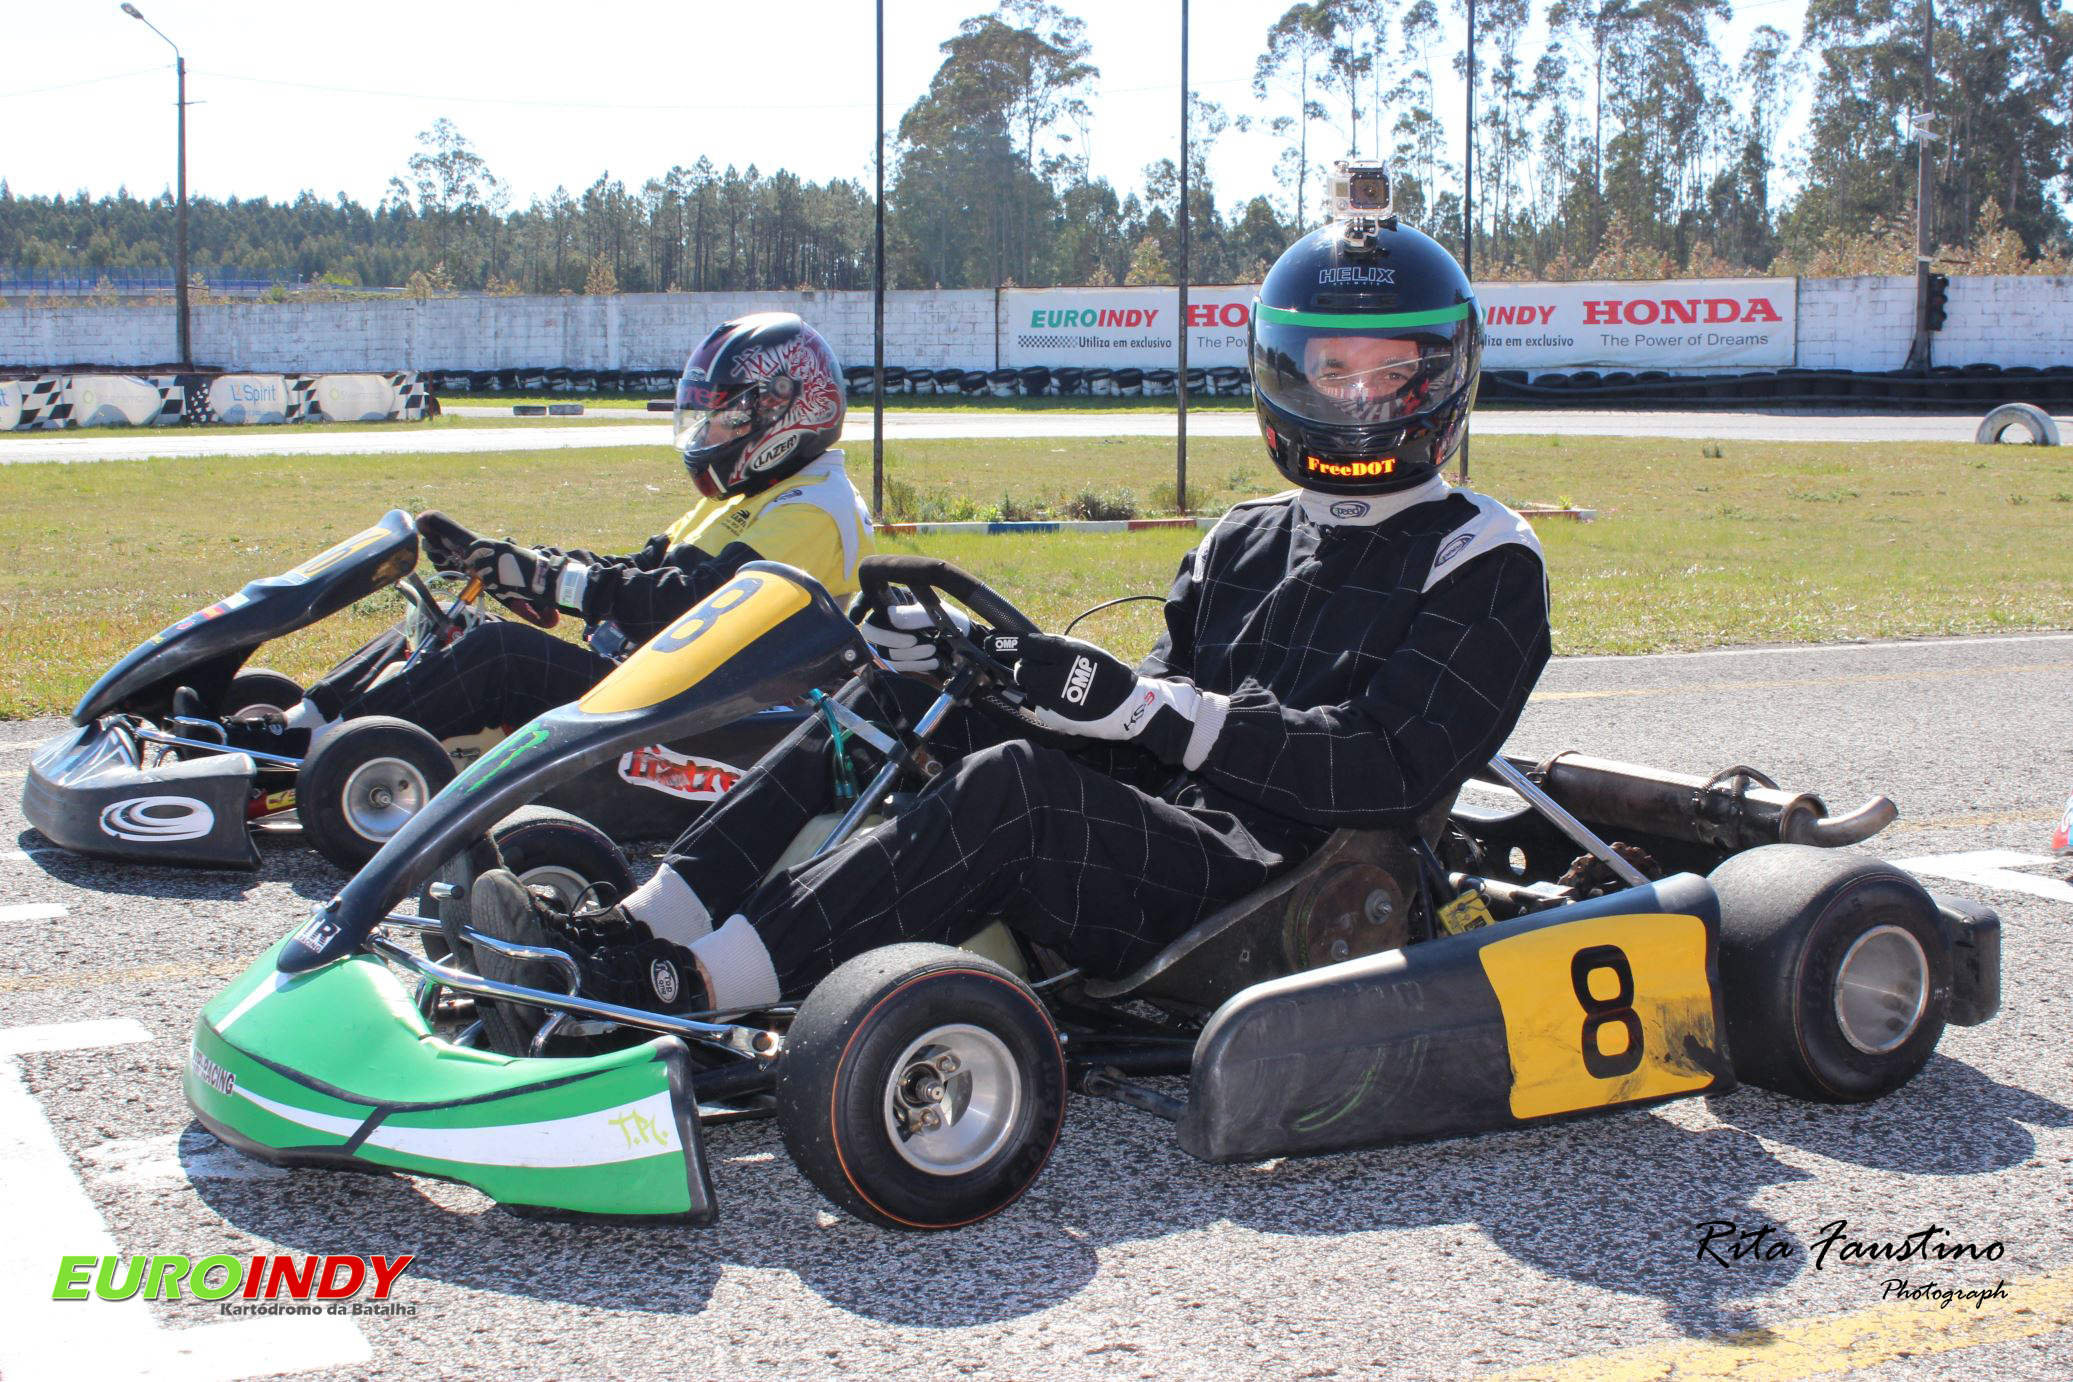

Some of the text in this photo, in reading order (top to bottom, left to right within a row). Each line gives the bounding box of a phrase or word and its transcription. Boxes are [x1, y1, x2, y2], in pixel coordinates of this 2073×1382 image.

[1318, 266, 1396, 284] HELIX
[1030, 308, 1159, 328] EUROINDY
[1582, 298, 1783, 325] HONDA
[1078, 335, 1172, 349] Utiliza em exclusivo
[1197, 336, 1222, 348] The
[1505, 338, 1523, 347] em
[1525, 333, 1574, 347] exclusivo
[1600, 333, 1769, 347] The Power of Dreams
[243, 384, 276, 406] Spirit
[755, 434, 797, 469] LAZER
[1306, 456, 1396, 477] FreeDOT
[651, 577, 764, 653] 8
[995, 636, 1019, 651] OMP
[1066, 656, 1094, 703] OMP
[1570, 944, 1645, 1080] 8
